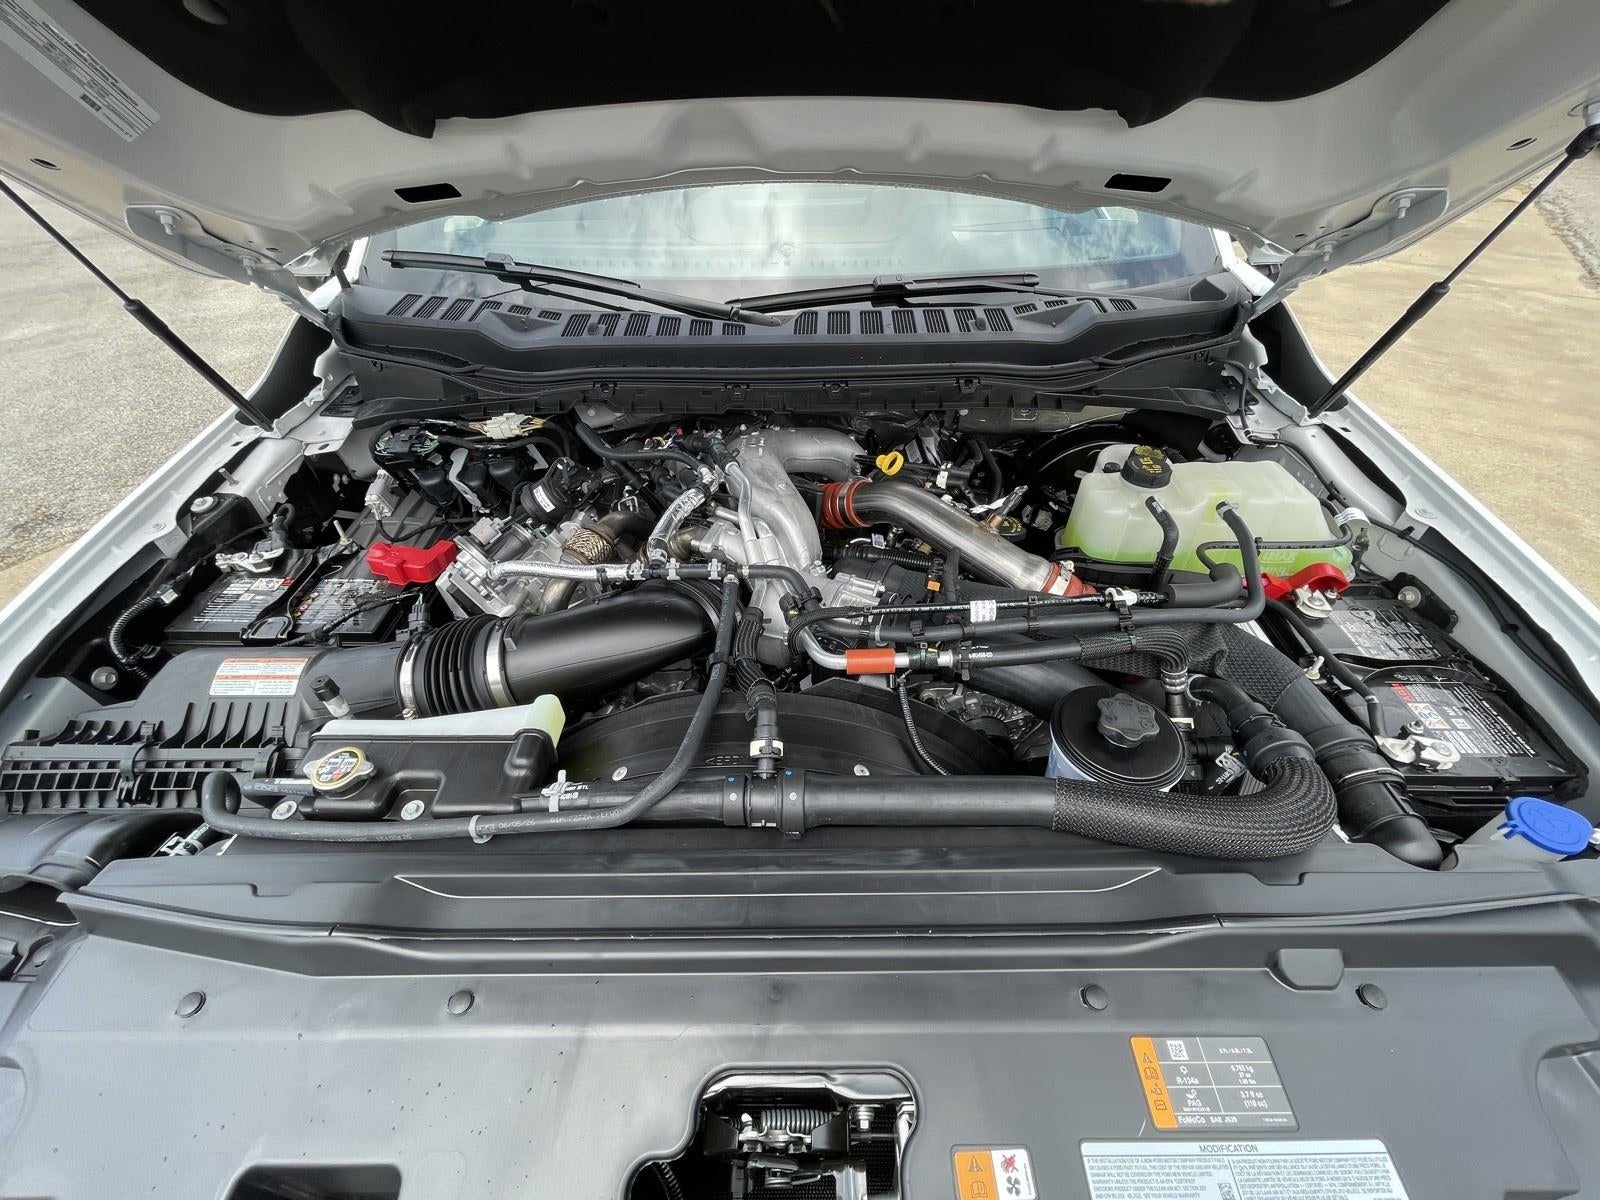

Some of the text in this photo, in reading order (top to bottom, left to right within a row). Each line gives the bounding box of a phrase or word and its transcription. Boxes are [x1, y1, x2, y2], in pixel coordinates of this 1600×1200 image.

[1176, 1076, 1199, 1085] R-134a
[1178, 1115, 1206, 1124] FoMoCo
[1198, 1143, 1259, 1153] MODIFICATION
